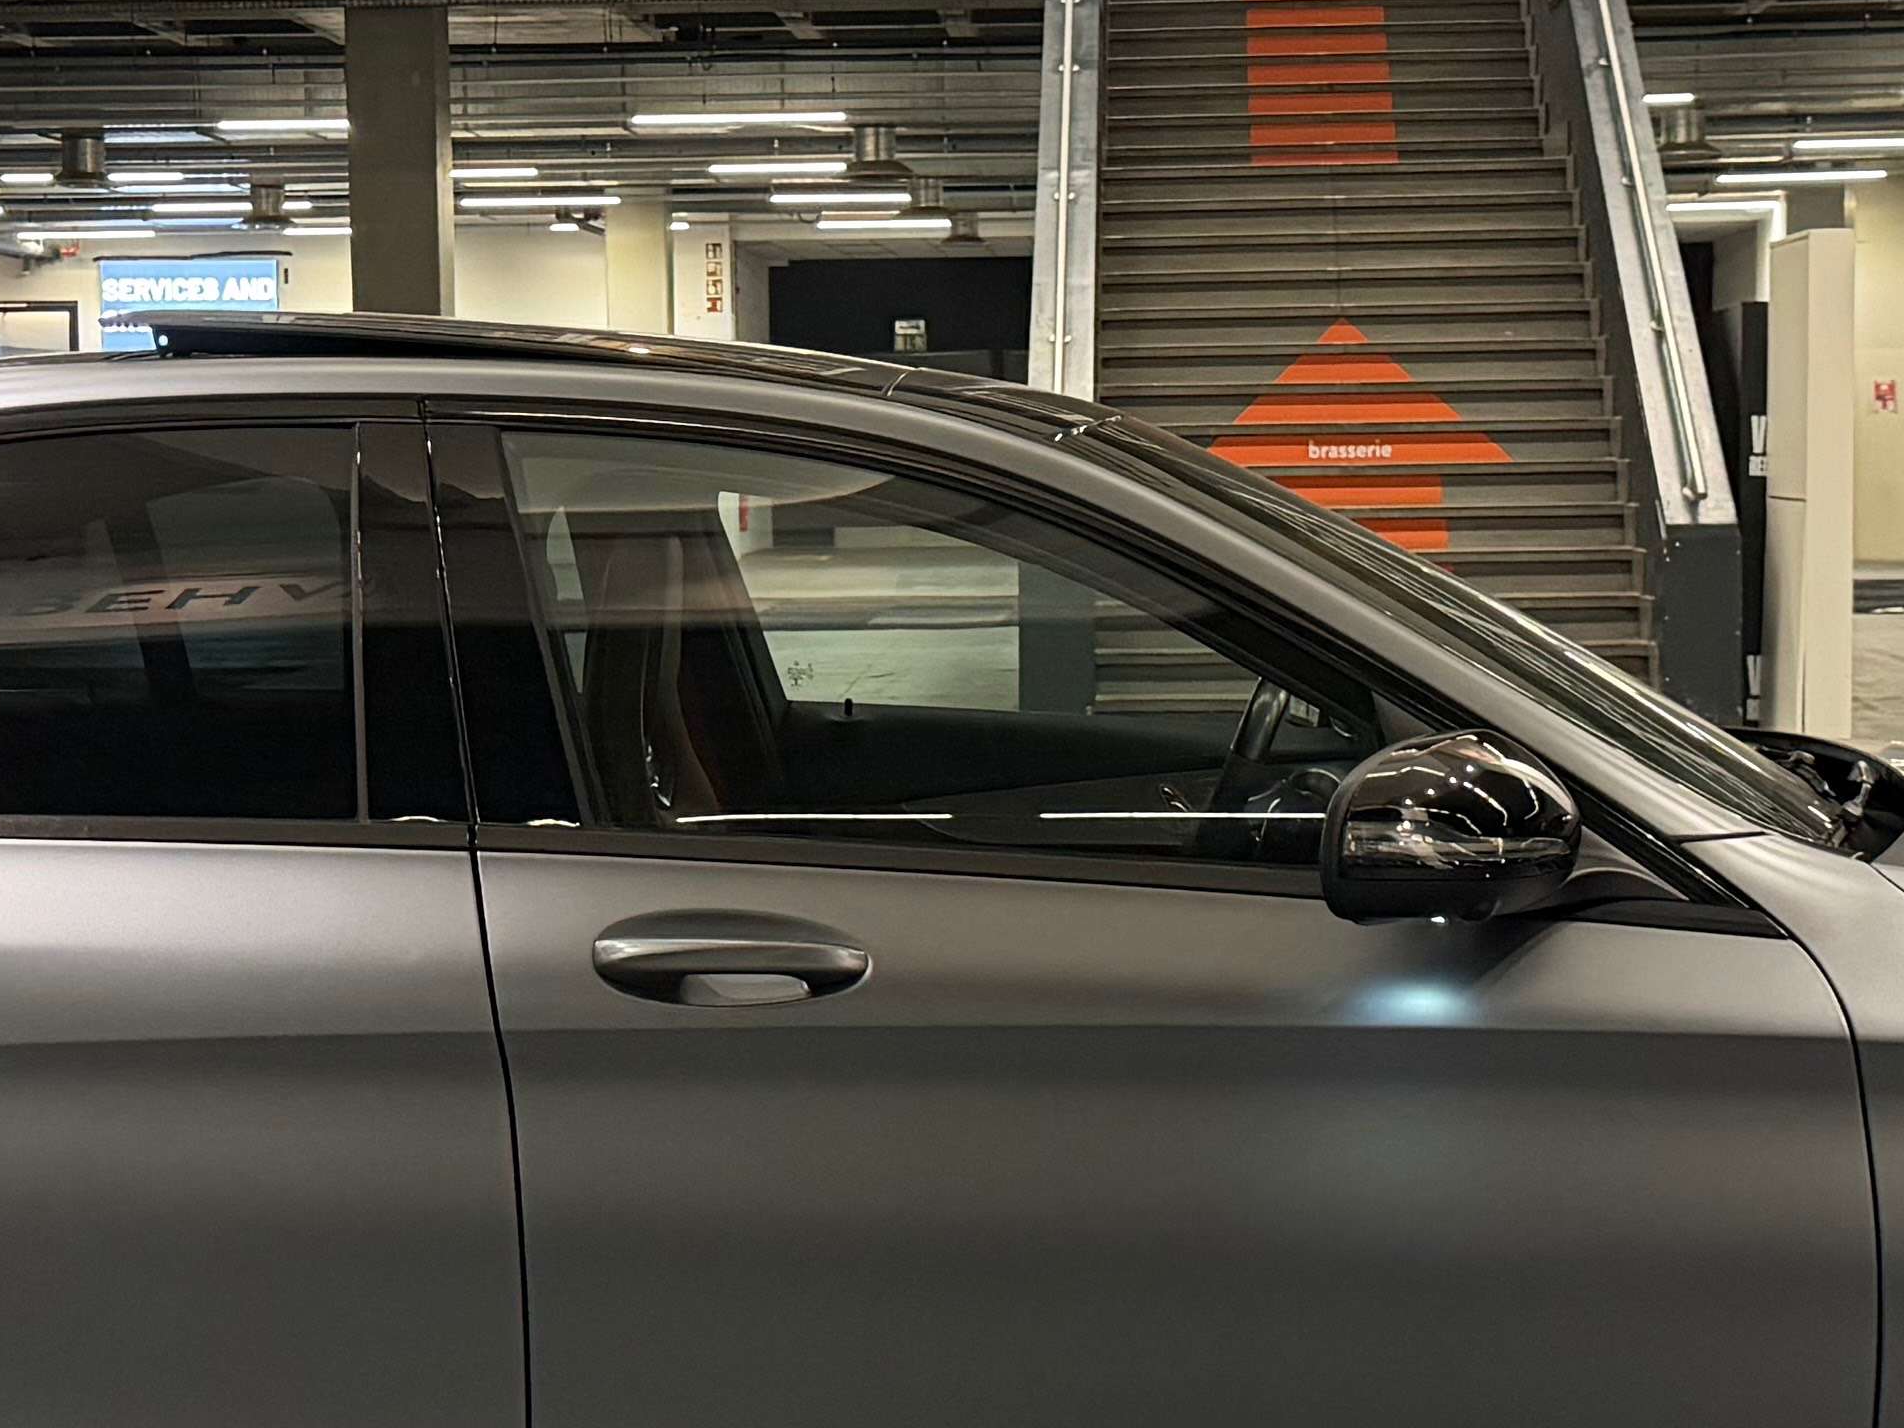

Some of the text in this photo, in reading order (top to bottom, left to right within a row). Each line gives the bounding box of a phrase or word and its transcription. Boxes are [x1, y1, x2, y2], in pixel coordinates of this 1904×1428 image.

[102, 276, 276, 303] SERVICES AND
[1308, 439, 1393, 459] brasserie
